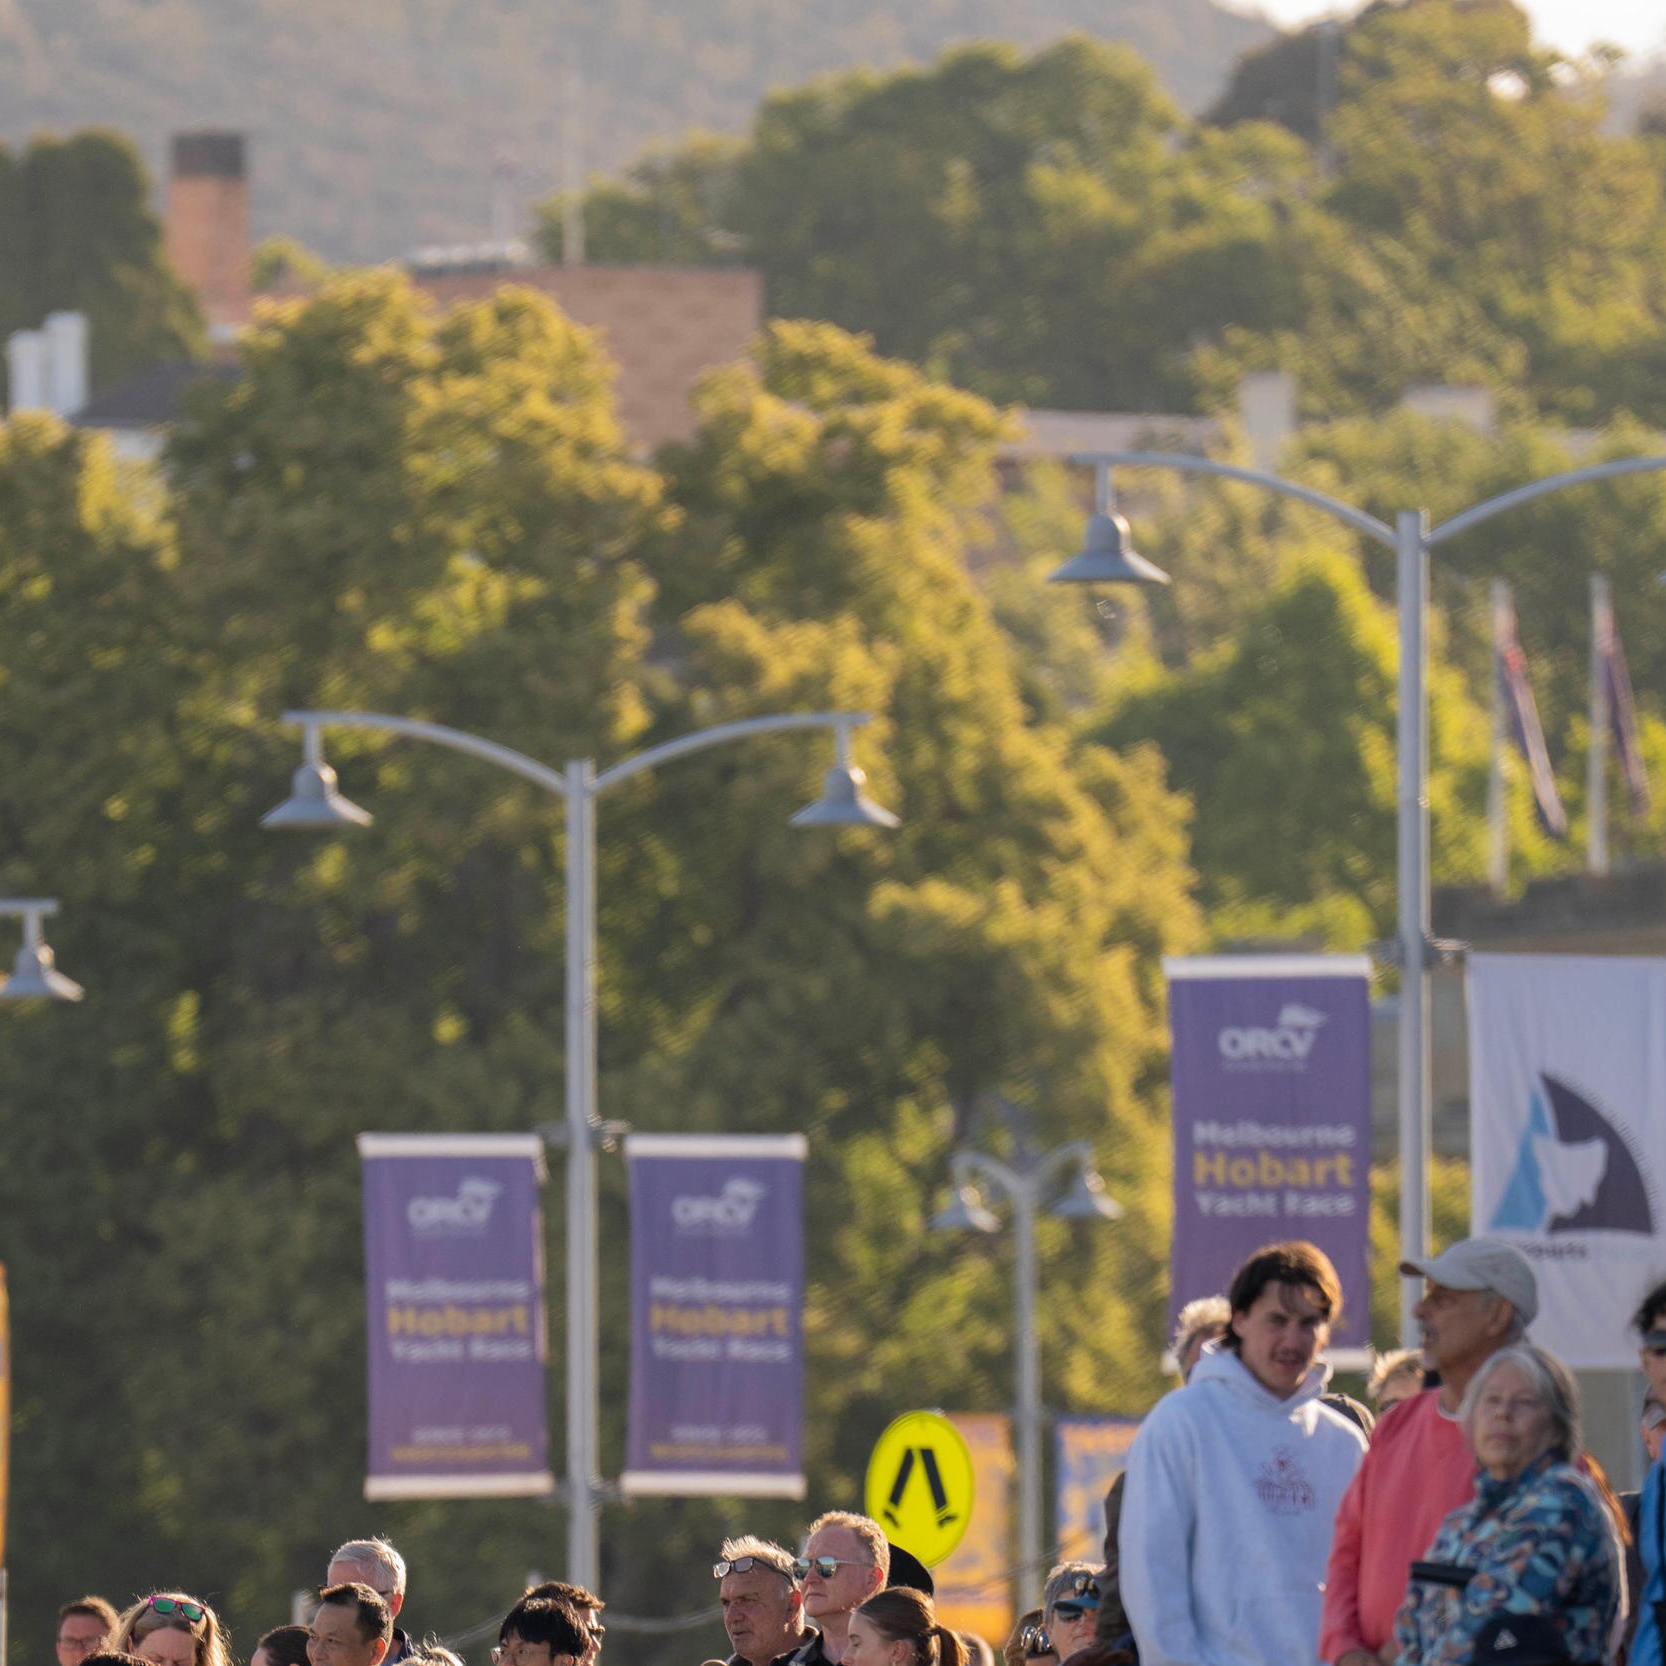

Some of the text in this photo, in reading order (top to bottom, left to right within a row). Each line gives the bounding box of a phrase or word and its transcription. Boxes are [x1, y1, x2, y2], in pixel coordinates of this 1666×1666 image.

[1193, 1151, 1355, 1187] Hobart
[387, 1303, 529, 1337] Hobart
[650, 1303, 789, 1337] Hobart
